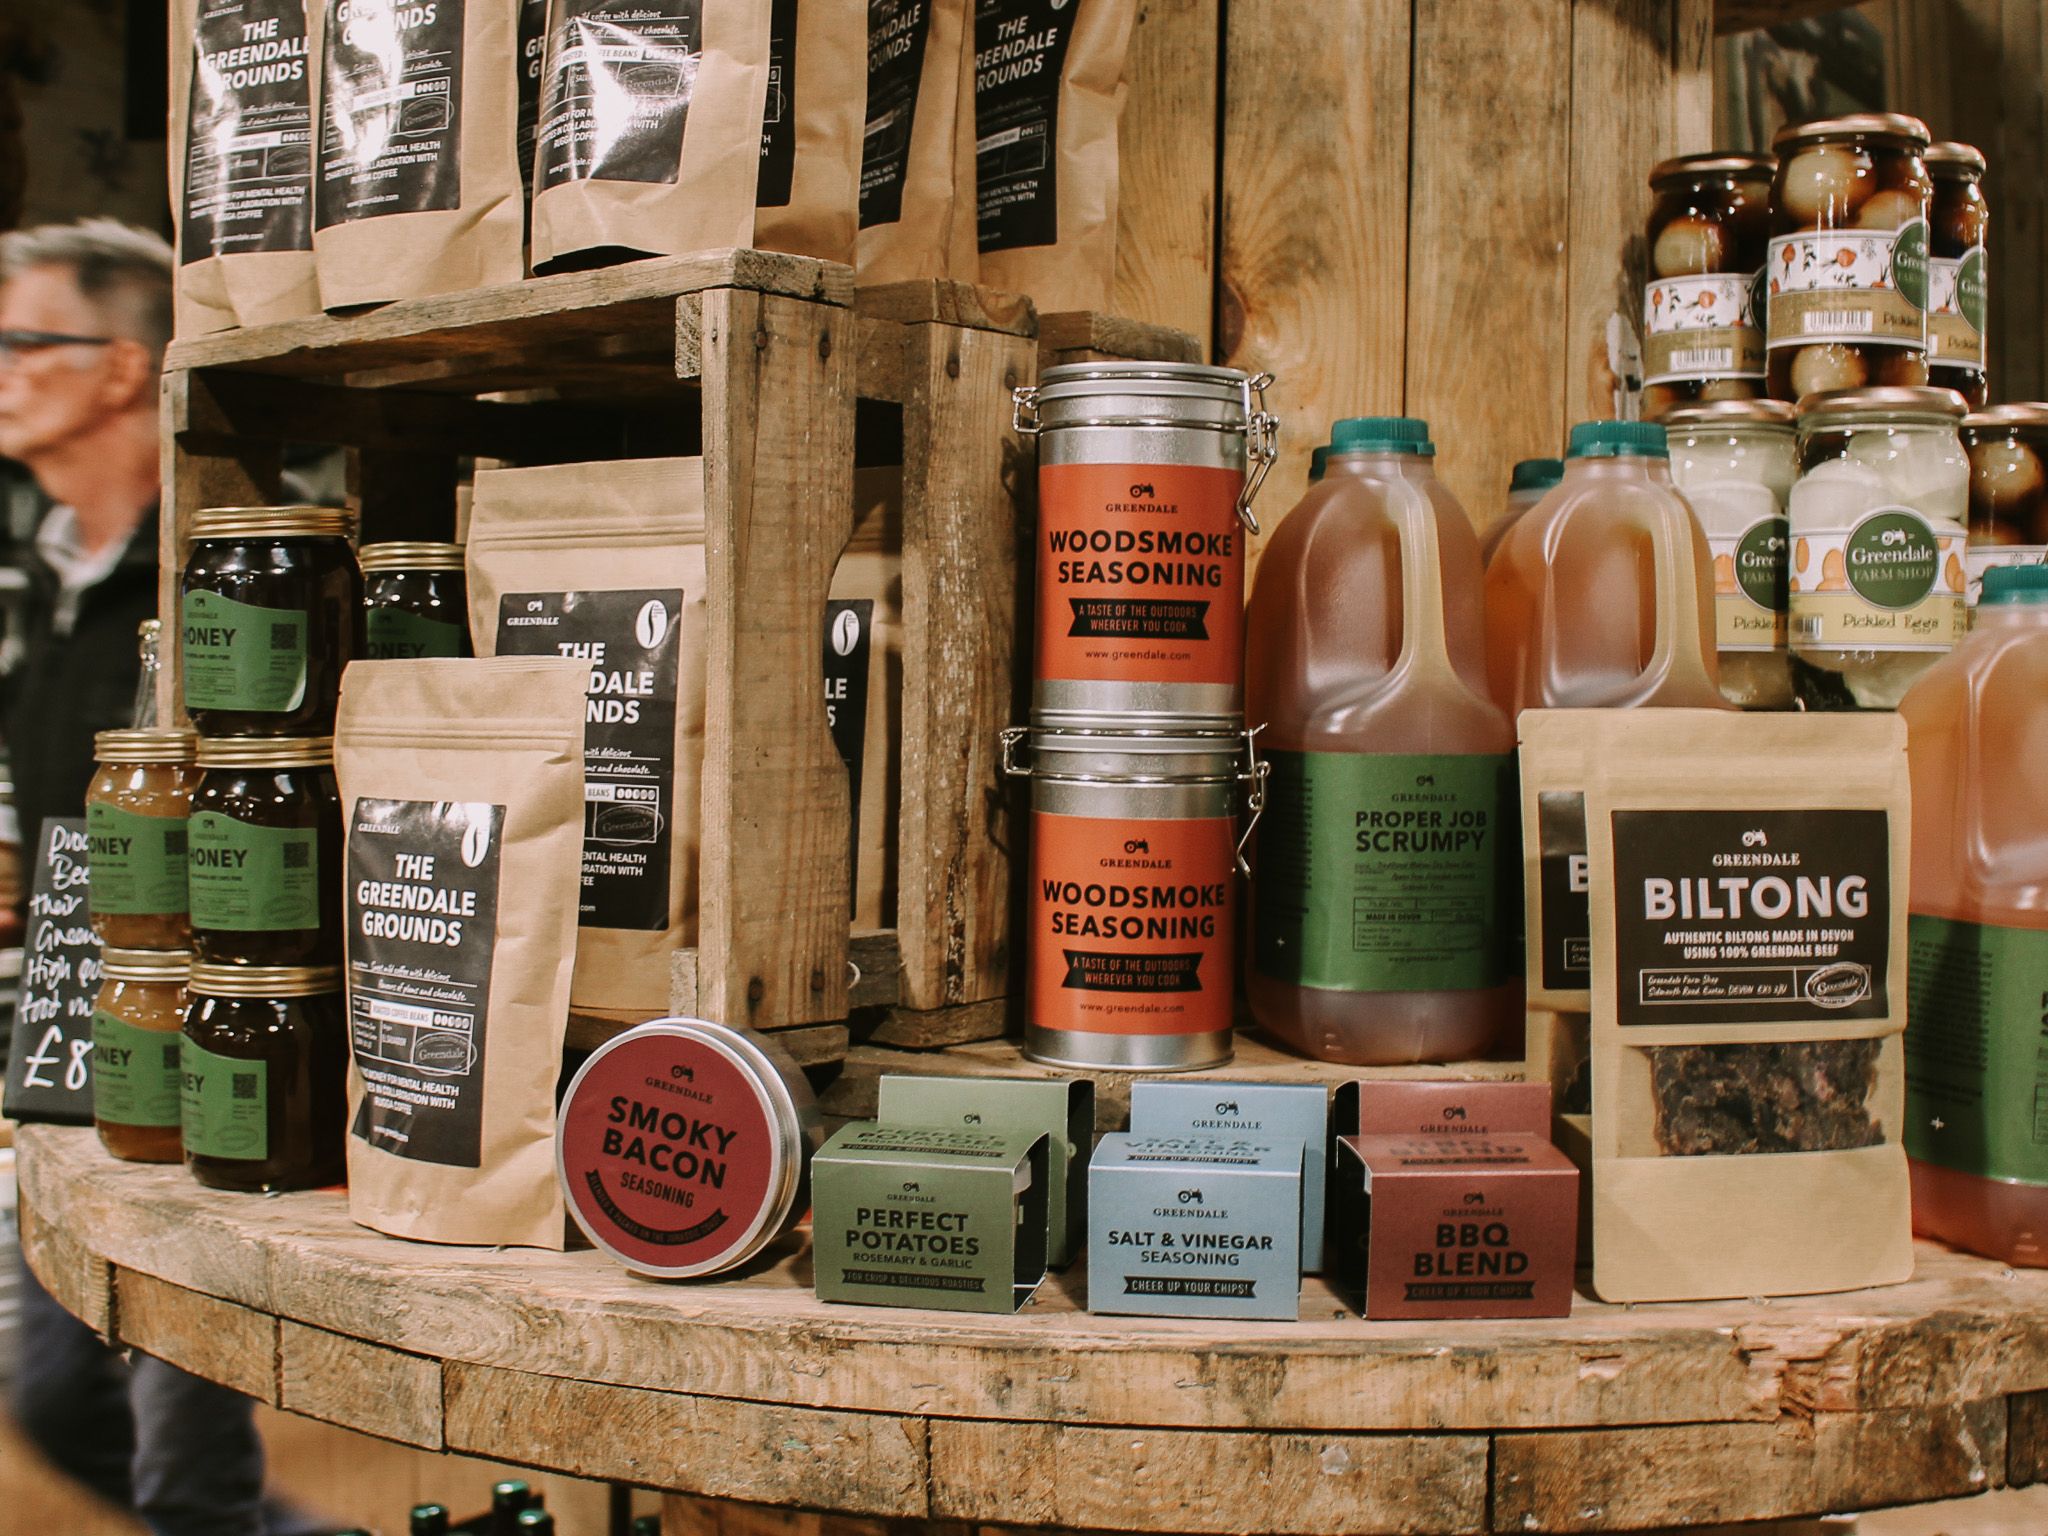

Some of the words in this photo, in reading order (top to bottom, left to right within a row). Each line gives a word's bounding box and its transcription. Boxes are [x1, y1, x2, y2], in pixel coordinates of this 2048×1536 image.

[612, 11, 629, 19] with
[242, 17, 279, 42] THE
[868, 4, 921, 51] EENDALE
[998, 16, 1029, 40] THE
[613, 50, 638, 58] BEANS
[976, 28, 1058, 69] REENDALE
[221, 60, 304, 90] ROUNDS
[977, 54, 1044, 93] ROUNDS
[633, 119, 658, 129] WITH
[1106, 503, 1178, 514] GREENDALE
[1050, 530, 1232, 557] WOODSMOKE
[1852, 545, 1933, 565] Greendale
[1058, 561, 1221, 587] SEASONING
[1854, 567, 1893, 582] FARM
[1897, 566, 1933, 581] SHOP
[1079, 605, 1085, 616] A
[1087, 604, 1113, 616] TASTE
[1115, 604, 1127, 616] OF
[1130, 605, 1147, 617] THE
[1150, 605, 1197, 618] OUTDOORS
[507, 616, 559, 626] GREENDALE
[1090, 619, 1139, 631] WHEREVER
[1143, 619, 1160, 632] YOU
[1163, 620, 1187, 633] COOK
[1843, 613, 1895, 628] Pickled
[1904, 615, 1938, 634] Eggs
[367, 641, 426, 657] ONEY
[558, 642, 606, 665] THE
[1085, 649, 1191, 661] www.greendale.com
[587, 788, 610, 797] BEANS
[1356, 811, 1442, 828] PROPER
[1448, 811, 1487, 828] JOB
[358, 823, 400, 835] GREENDALE
[89, 837, 132, 855] ONEY
[1356, 830, 1486, 852] SCRUMPY
[583, 852, 607, 861] ENTAL
[609, 853, 647, 864] HEALTH
[1100, 858, 1172, 869] GREENDALE
[1712, 853, 1800, 867] GREENDALE
[53, 855, 90, 890] Bee
[395, 853, 435, 881] THE
[618, 864, 643, 876] WITH
[357, 880, 476, 917] GREENDALE
[1043, 879, 1225, 909] WOODSMOKE
[1644, 875, 1868, 920] BILTONG
[361, 911, 463, 947] GROUNDS
[1052, 911, 1215, 939] SEASONING
[35, 920, 104, 952] Green
[1664, 931, 1722, 945] AUTHENTIC
[1725, 930, 1769, 943] BILTONG
[1772, 930, 1804, 943] MADE
[1806, 929, 1818, 942] IN
[1820, 929, 1854, 942] DEVON
[1684, 946, 1717, 960] USING
[1719, 946, 1749, 959] 100%
[1751, 945, 1812, 958] GREENDALE
[1815, 944, 1839, 957] BEEF
[27, 955, 71, 990] High
[1073, 957, 1079, 968] A
[1081, 957, 1107, 969] TASTE
[1110, 958, 1121, 970] OF
[1125, 959, 1142, 971] THE
[1145, 959, 1191, 971] OUTDOORS
[1084, 972, 1133, 985] WHEREVER
[1136, 974, 1154, 986] YOU
[1157, 974, 1180, 986] COOK
[1728, 984, 1754, 995] DEVON
[1080, 1002, 1184, 1013] www.greendale.com
[96, 1048, 132, 1067] NEY
[419, 1047, 466, 1060] Greendale
[422, 1081, 460, 1097] HEALTH
[645, 1077, 713, 1105] GREENDALE
[430, 1096, 456, 1110] WITH
[608, 1096, 737, 1155] SMOKY
[1192, 1120, 1262, 1130] GREENDALE
[1420, 1125, 1488, 1134] GREENDALE
[602, 1128, 727, 1189] BACON
[620, 1172, 695, 1208] SEASONING
[887, 1194, 936, 1203] GREENDALE
[857, 1208, 969, 1232] PERFECT
[1153, 1208, 1228, 1219] GREENDALE
[1442, 1208, 1504, 1217] GREENDALE
[846, 1230, 979, 1256] POTATOES
[1108, 1230, 1155, 1246] SALT
[1161, 1233, 1175, 1247] &
[1181, 1233, 1273, 1250] VINEGAR
[1436, 1222, 1509, 1248] BBQ
[853, 1252, 915, 1266] ROSEMARY
[919, 1256, 927, 1266] &
[931, 1257, 973, 1269] GARLIC
[1141, 1251, 1239, 1266] SEASONING
[1414, 1252, 1528, 1277] BLEND
[847, 1272, 864, 1281] FOR
[865, 1273, 888, 1283] CRISP
[900, 1275, 940, 1287] DELICIOUS
[942, 1277, 980, 1289] ROASTIES
[1131, 1279, 1164, 1291] CHEER
[1168, 1280, 1181, 1292] UP
[1184, 1281, 1211, 1293] YOUR
[1214, 1282, 1249, 1295] CHIPS!
[1412, 1286, 1443, 1297] CHEER
